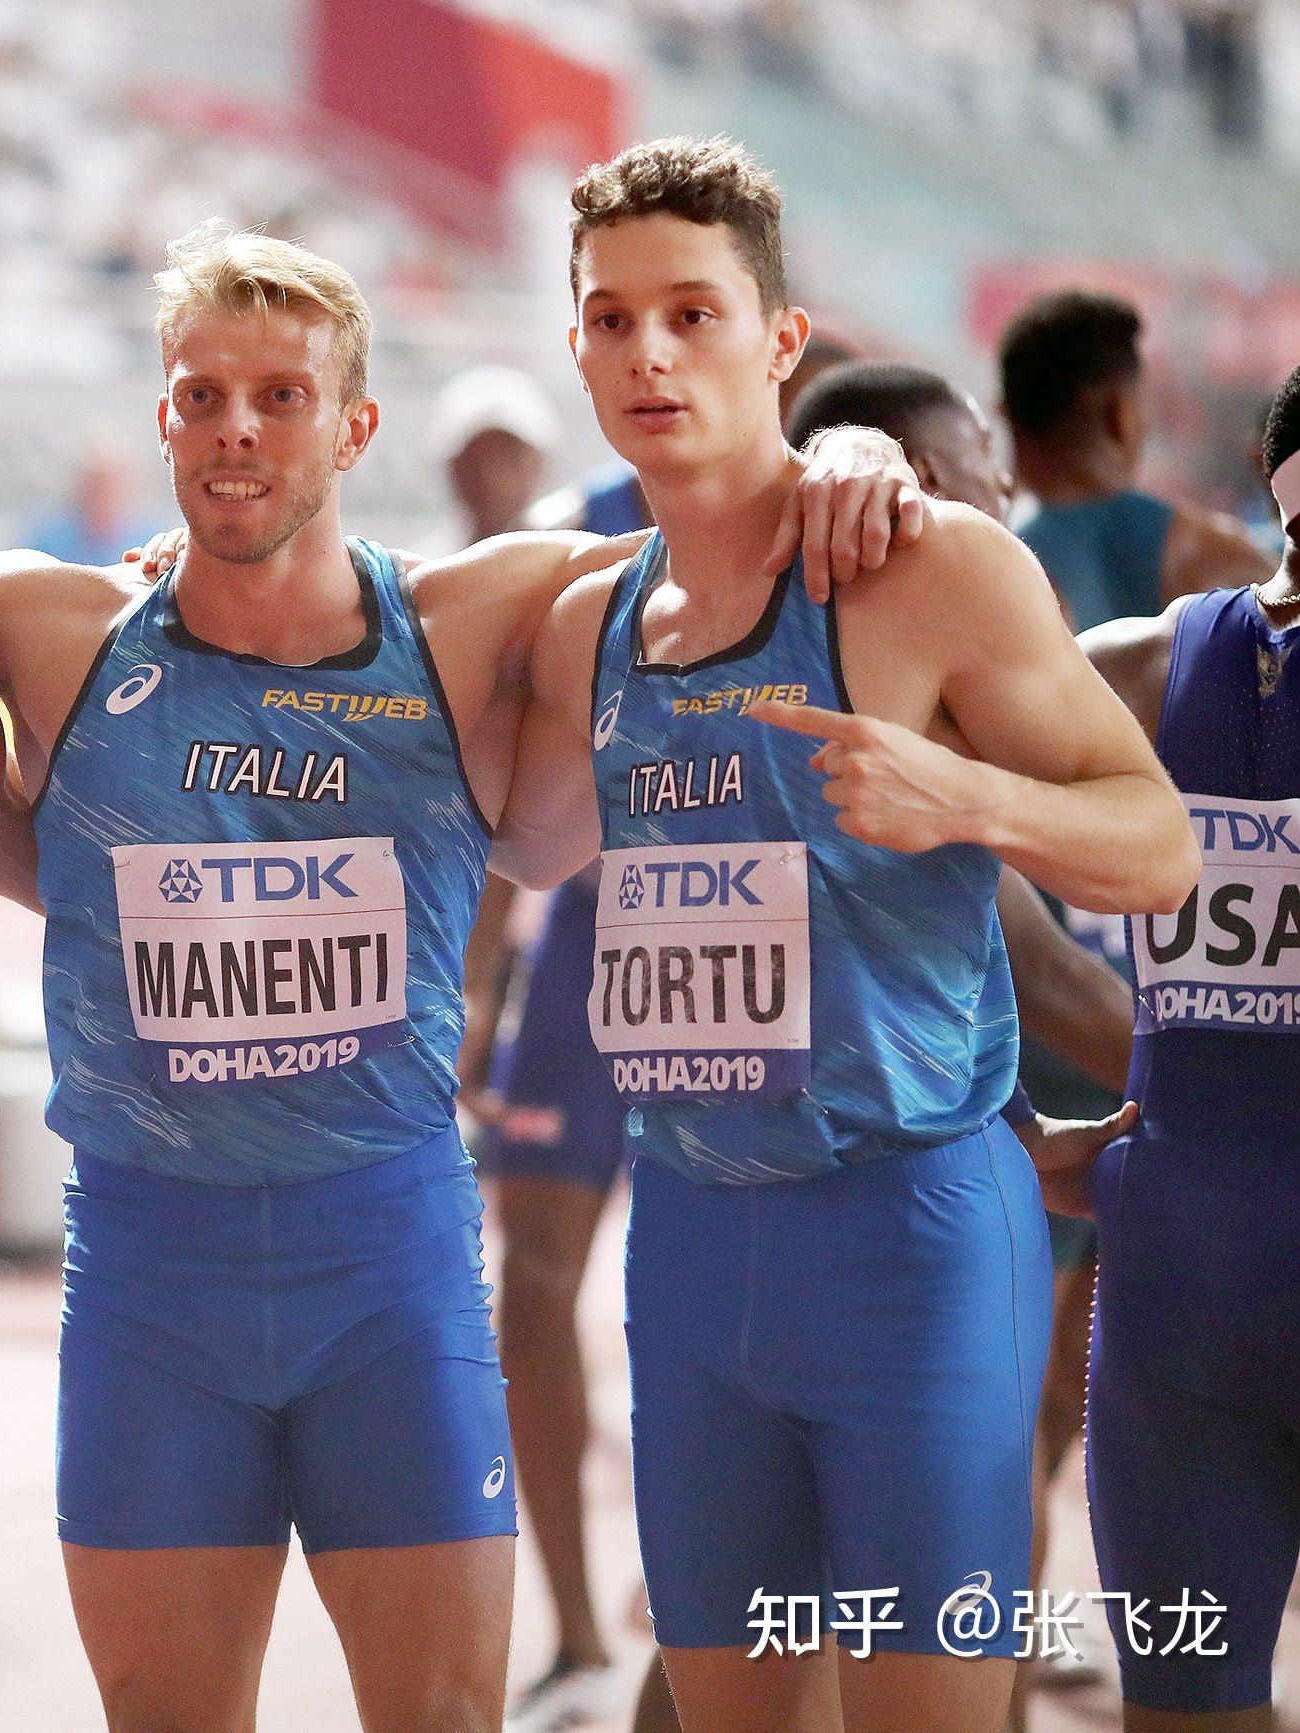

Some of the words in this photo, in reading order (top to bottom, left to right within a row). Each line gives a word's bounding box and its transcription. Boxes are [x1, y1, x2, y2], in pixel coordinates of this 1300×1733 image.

[261, 690, 427, 722] FASTWEB
[181, 740, 347, 803] ITALIA
[627, 752, 744, 817] ITALIA
[1189, 807, 1300, 854] TDK
[202, 854, 359, 902] TDK
[645, 860, 764, 907] TDK
[1145, 882, 1300, 968] USA
[134, 933, 388, 1018] MANENTI
[601, 943, 786, 1027] TORTU
[168, 1036, 361, 1084] DOHA2019
[613, 1056, 766, 1092] DOHA2019
